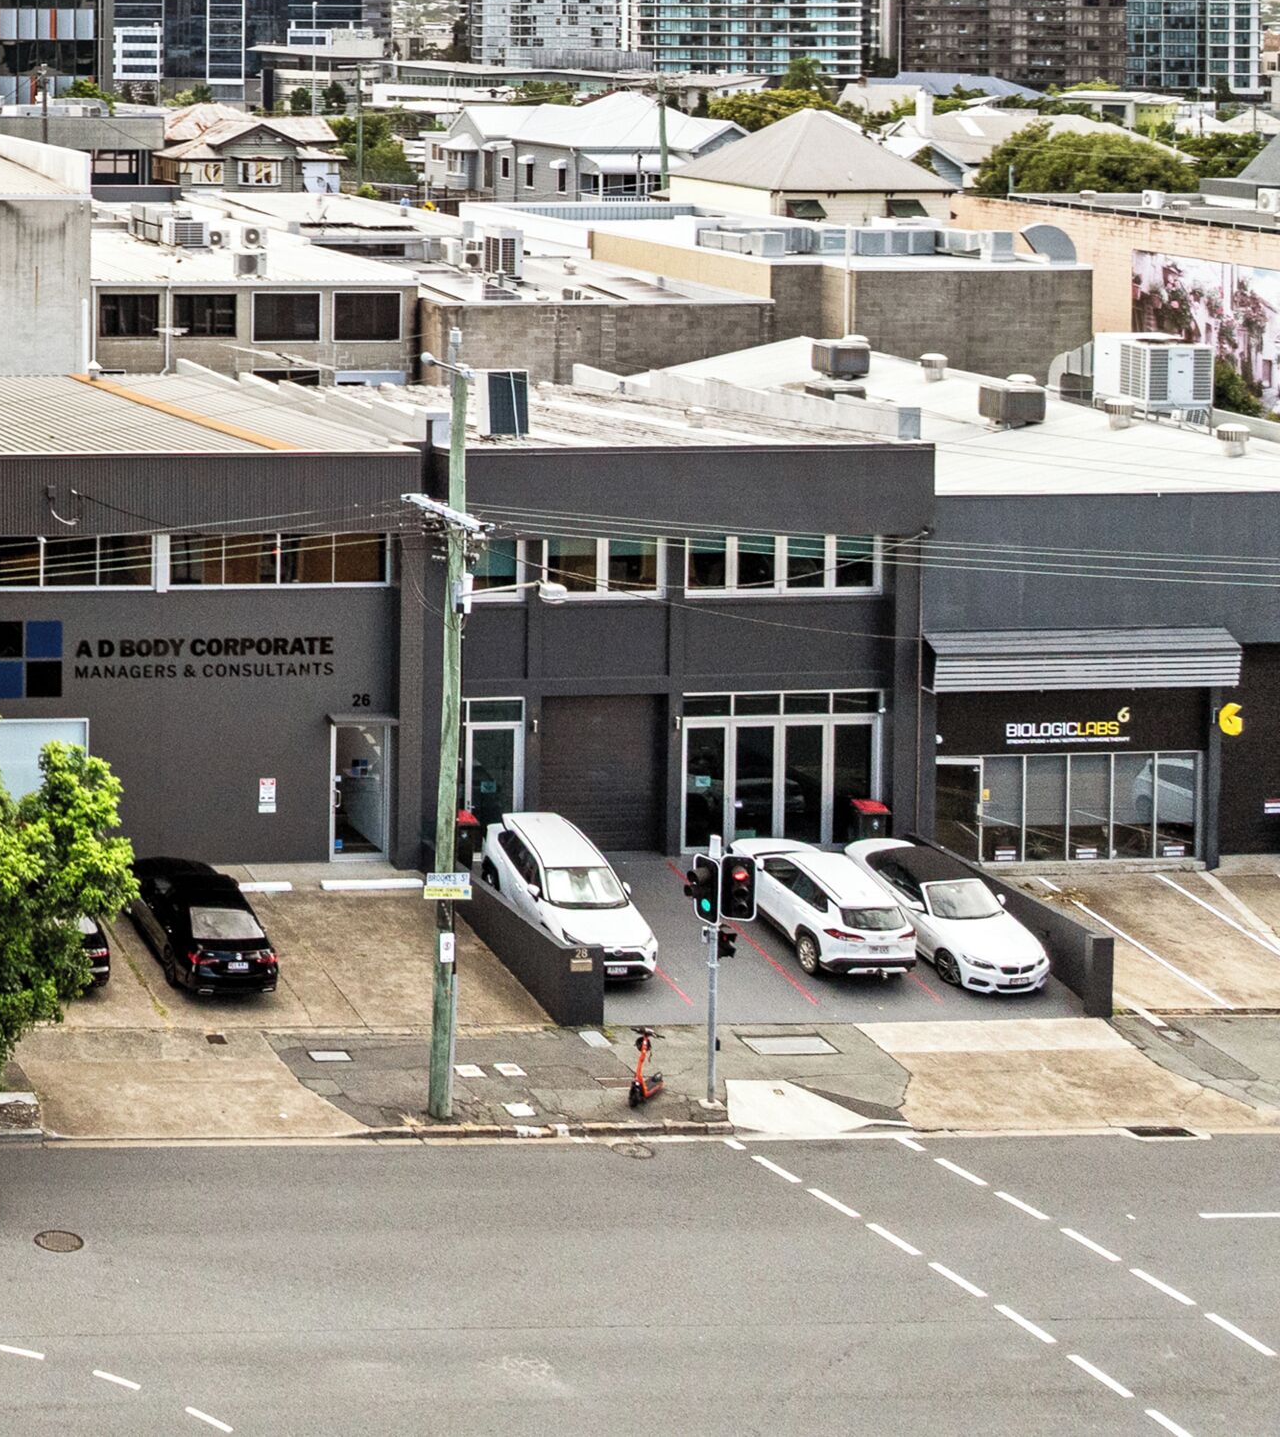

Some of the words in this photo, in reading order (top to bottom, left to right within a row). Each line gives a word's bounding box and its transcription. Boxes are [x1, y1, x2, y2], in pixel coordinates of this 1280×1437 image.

[75, 640, 92, 658] A
[98, 640, 114, 658] D
[120, 638, 185, 657] BODY
[190, 637, 334, 656] CORPORATE
[74, 664, 177, 679] MANAGERS
[183, 664, 196, 678] &
[203, 662, 335, 678] CONSULTANTS
[352, 694, 371, 707] 26
[575, 949, 589, 958] 28
